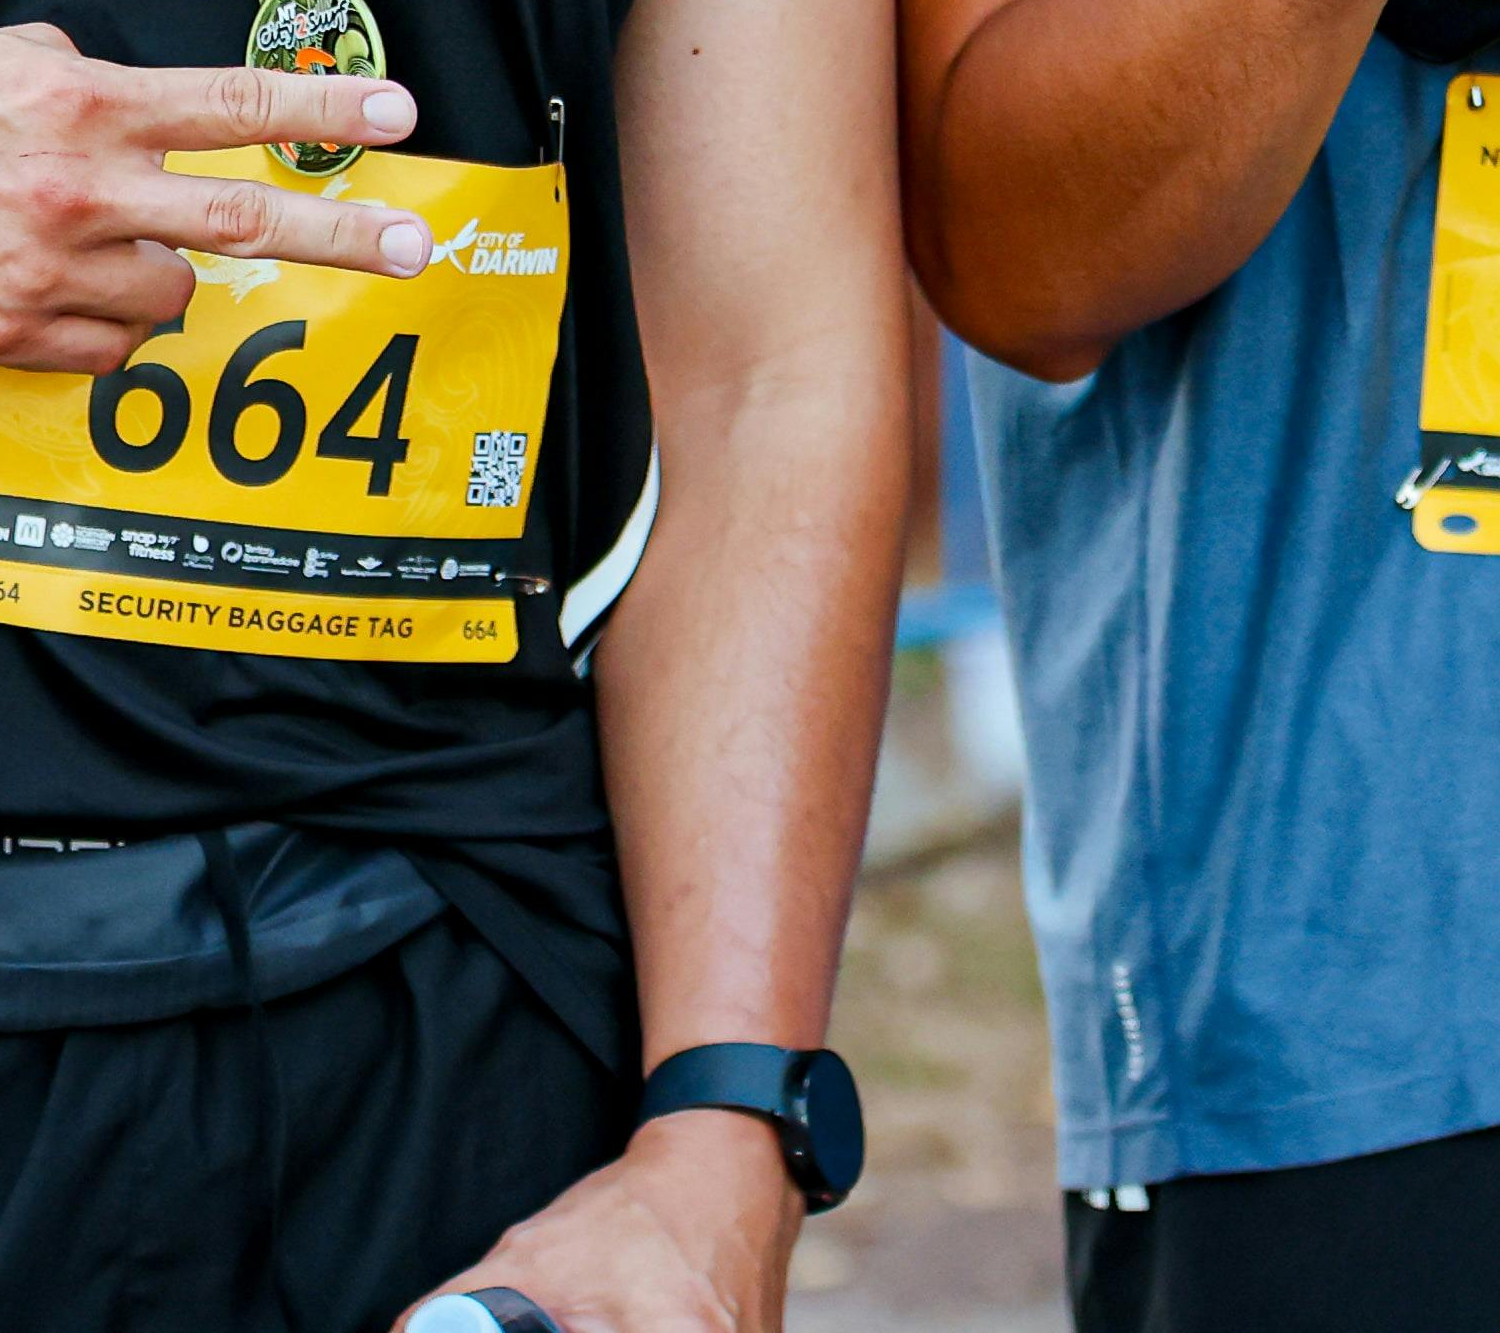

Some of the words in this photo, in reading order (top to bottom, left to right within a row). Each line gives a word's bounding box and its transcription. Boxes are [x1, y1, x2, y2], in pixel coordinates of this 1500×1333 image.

[276, 0, 297, 22] NT
[476, 232, 505, 248] CITY
[506, 232, 525, 248] OF
[469, 247, 558, 275] DARWIN
[88, 317, 421, 498] 664
[78, 588, 220, 627] SECURITY
[227, 606, 360, 638] BAGGAGE
[367, 617, 414, 640] TAG
[462, 618, 499, 642] 664
